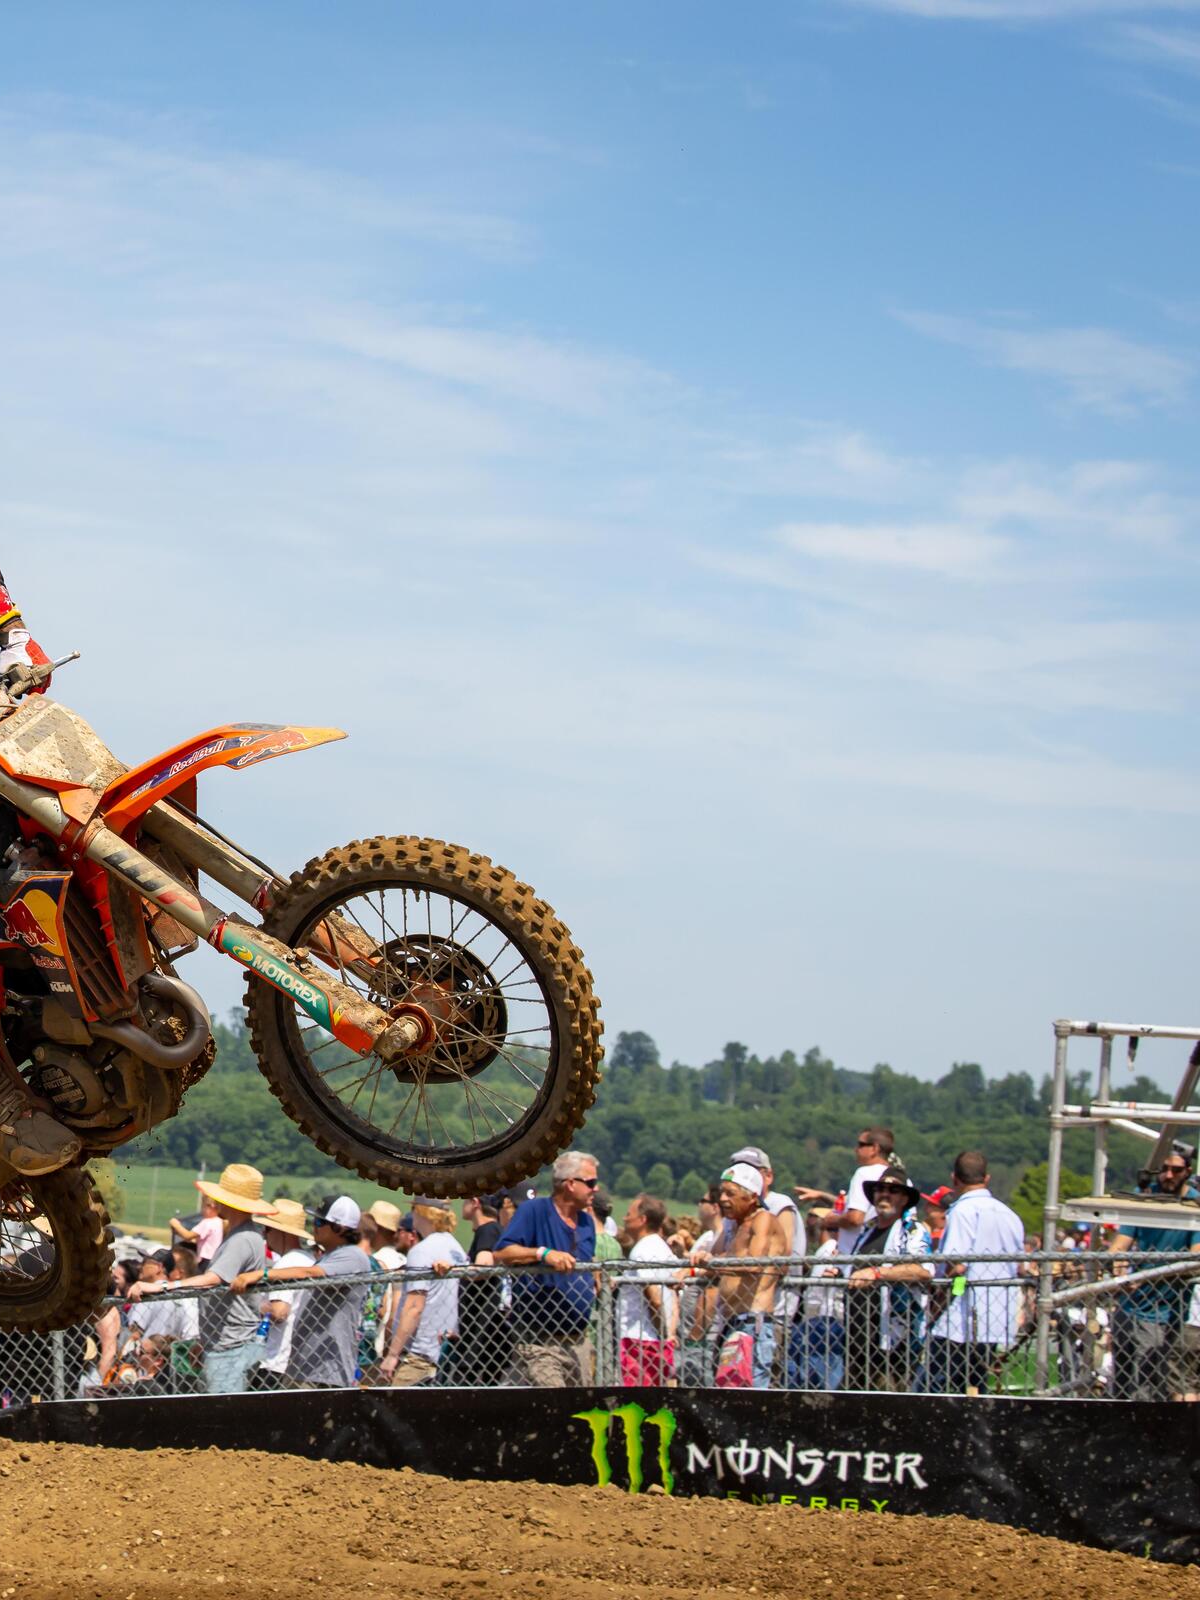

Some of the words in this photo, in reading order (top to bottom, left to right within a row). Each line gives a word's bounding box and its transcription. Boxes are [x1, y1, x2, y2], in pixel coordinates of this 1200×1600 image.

[50, 981, 74, 992] KTM
[251, 954, 323, 1009] MOTOREX
[686, 1438, 928, 1490] MONSTER
